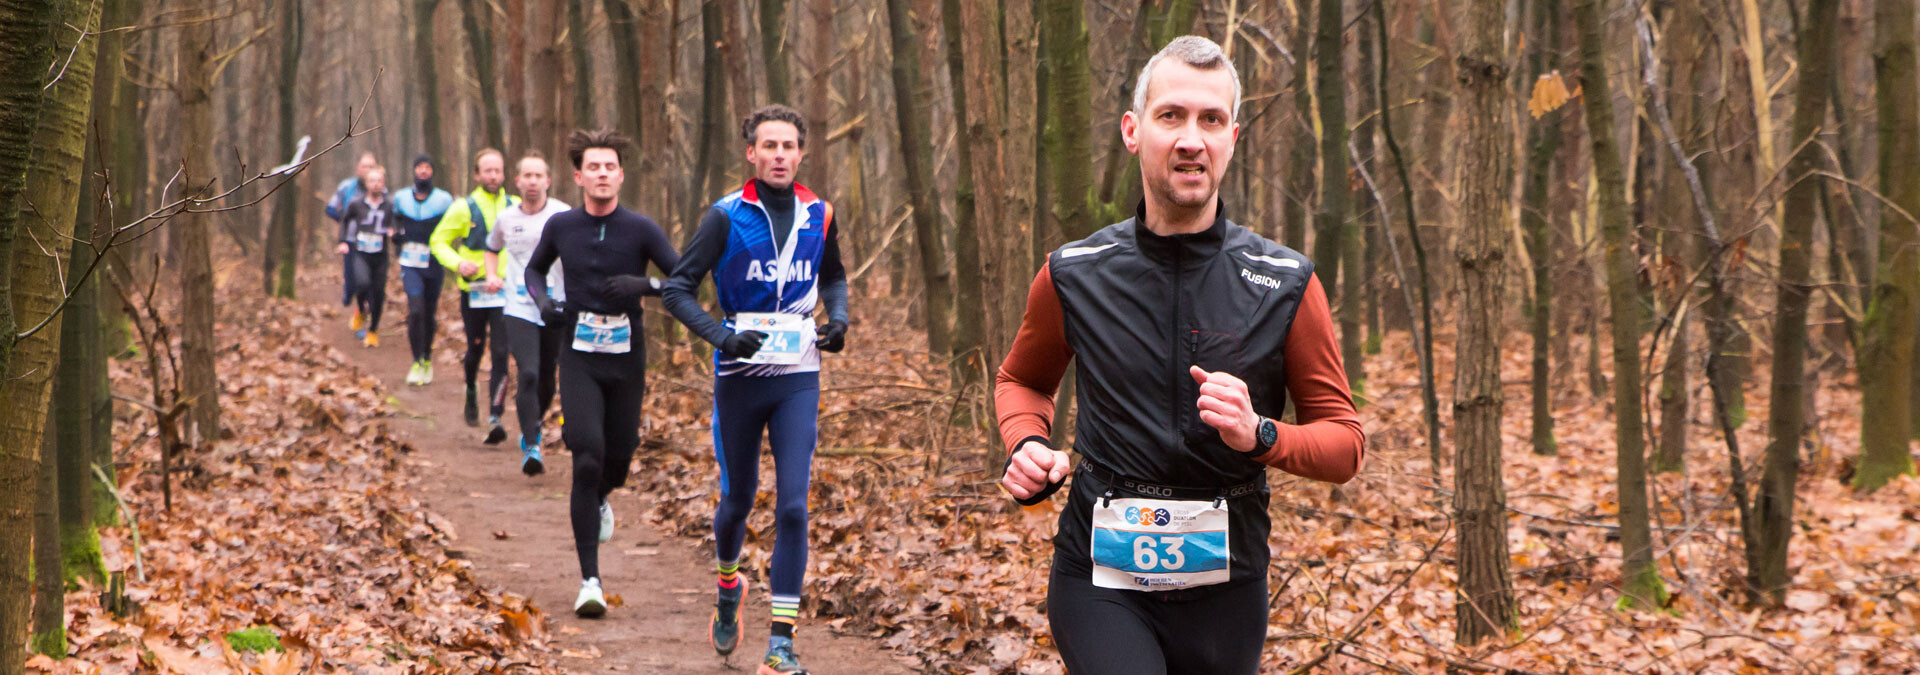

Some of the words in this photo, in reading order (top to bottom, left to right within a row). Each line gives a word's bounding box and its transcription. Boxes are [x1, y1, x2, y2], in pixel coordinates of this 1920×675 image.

[745, 259, 812, 283] ASML
[1240, 268, 1281, 289] FUSION
[592, 327, 614, 345] 72
[1133, 535, 1185, 571] 63
